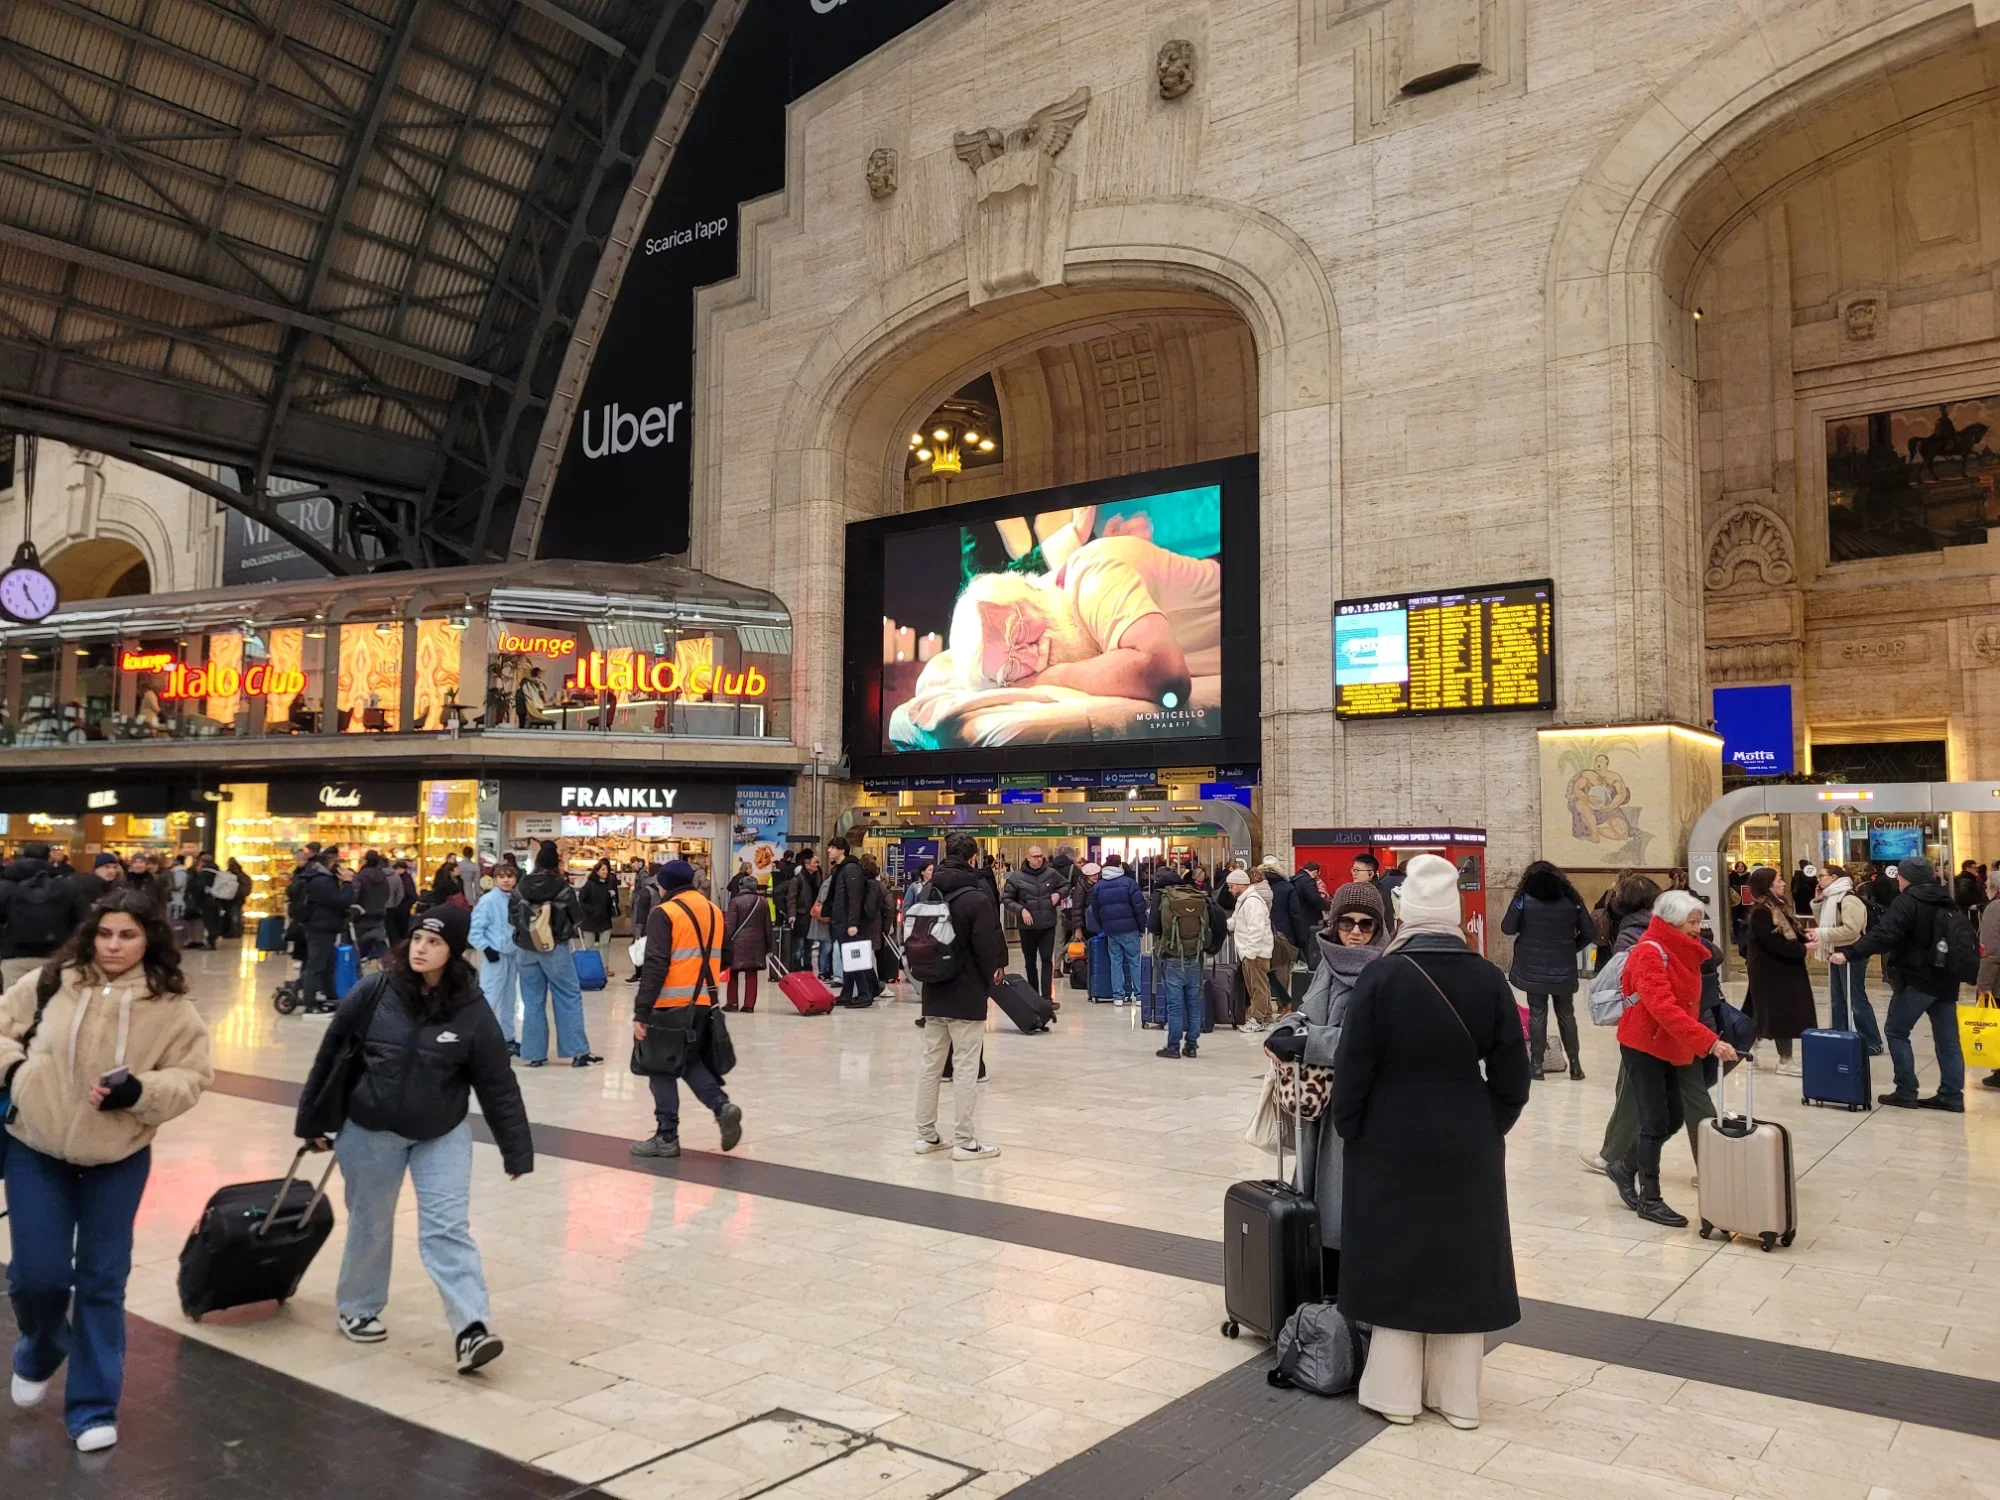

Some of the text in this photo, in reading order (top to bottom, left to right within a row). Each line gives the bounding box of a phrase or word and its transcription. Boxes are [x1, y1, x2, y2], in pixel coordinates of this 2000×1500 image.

[645, 217, 728, 256] Scarica l'app
[582, 401, 683, 459] Uber
[1340, 601, 1400, 614] 09.12.2024
[499, 632, 576, 658] lounge
[123, 653, 172, 673] lounge
[1136, 710, 1204, 720] MONTICELLO
[1732, 751, 1775, 760] Motta
[561, 787, 678, 808] FRANKLY
[738, 808, 785, 816] BREAKFAST
[1874, 817, 1922, 830] Centrale
[1695, 866, 1712, 884] C
